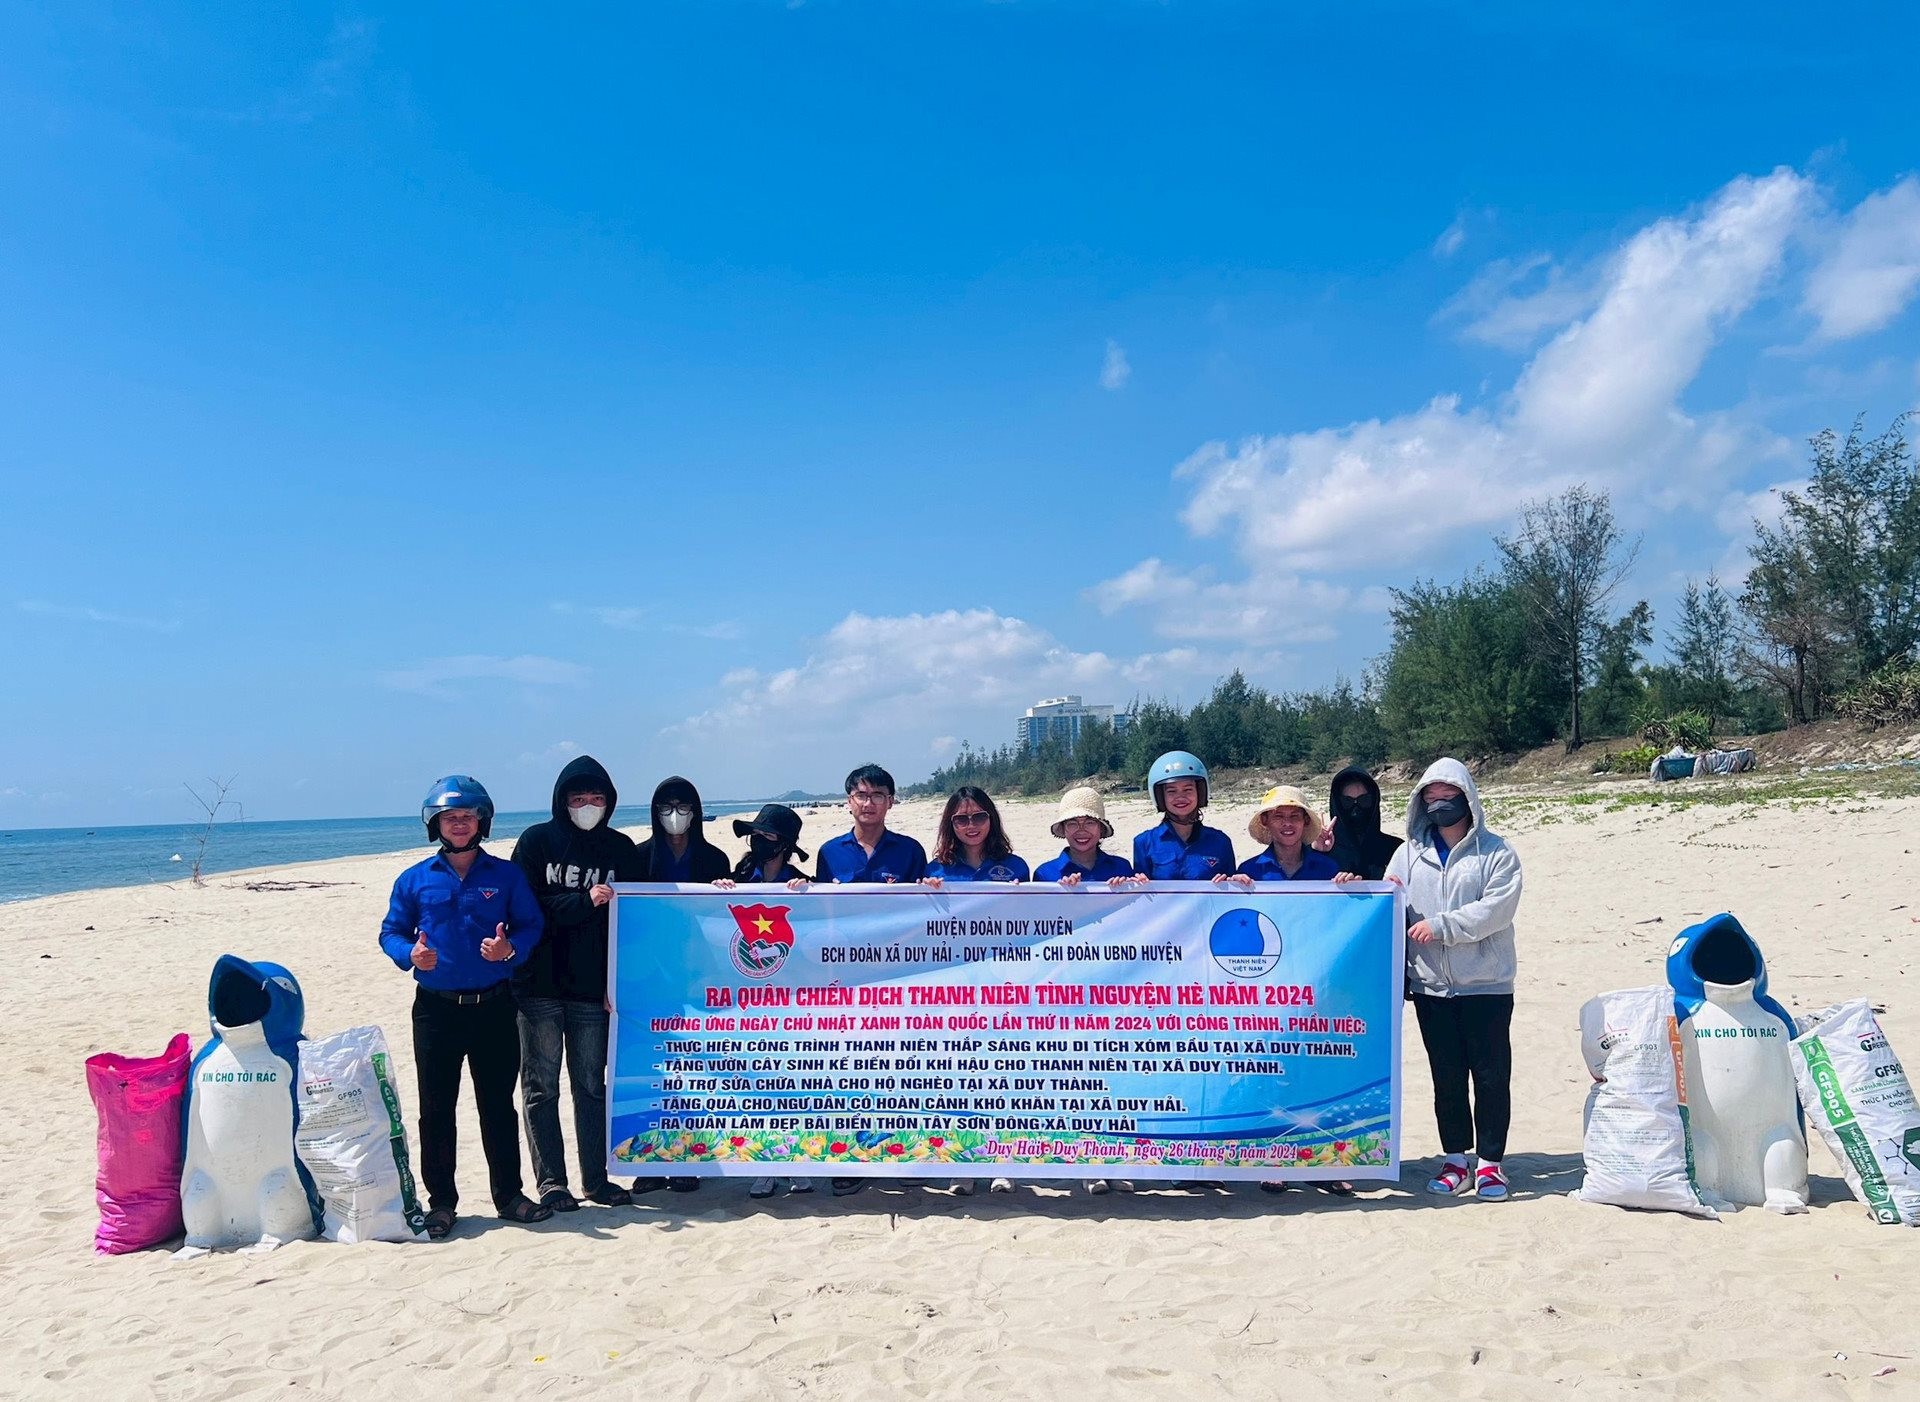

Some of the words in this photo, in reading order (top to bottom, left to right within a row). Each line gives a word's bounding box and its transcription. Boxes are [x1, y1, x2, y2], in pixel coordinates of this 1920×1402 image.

[927, 916, 966, 939] HUYỆN
[970, 916, 1001, 936] ĐOÀN
[1006, 920, 1030, 936] DUY
[1033, 916, 1073, 936] XUYÊN
[822, 947, 846, 963] BCH
[850, 943, 881, 962] ĐOÀN
[885, 943, 900, 962] XÃ
[904, 947, 928, 962] DUY
[932, 940, 951, 962] HẢI
[964, 946, 988, 962] DUY
[991, 942, 1031, 962] THÀNH
[1043, 946, 1063, 961] CHI
[1067, 941, 1100, 961] ĐOÀN
[1104, 945, 1137, 961] UBND
[1141, 941, 1182, 965] HUYỆN
[706, 987, 732, 1007] RA
[737, 984, 790, 1011] QUÂN
[796, 980, 854, 1006] CHIẾN
[859, 986, 903, 1009] DỊCH
[908, 986, 975, 1005] THANH
[981, 982, 1030, 1005] NIÊN
[1035, 982, 1083, 1005] TÌNH
[1089, 982, 1171, 1009] NGUYỆN
[1177, 982, 1204, 1005] HÈ
[1209, 981, 1259, 1005] NĂM
[1264, 985, 1314, 1005] 2024
[651, 1014, 700, 1031] HƯỞNG
[705, 1015, 736, 1031] ỨNG
[740, 1015, 778, 1030] NGÀY
[783, 1013, 813, 1030] CHỦ
[817, 1014, 856, 1033] NHẬT
[860, 1016, 900, 1030] XANH
[905, 1014, 943, 1030] TOÀN
[948, 1012, 988, 1031] QUỐC
[993, 1012, 1022, 1030] LẦN
[1026, 1014, 1056, 1030] THỨ
[1060, 1016, 1069, 1030] II
[1074, 1014, 1110, 1030] NĂM
[1114, 1016, 1152, 1030] 2024
[1157, 1014, 1181, 1030] VỚI
[1186, 1014, 1229, 1031] CÔNG
[1233, 1014, 1284, 1032] TRÌNH,
[1288, 1013, 1329, 1032] PHẦN
[1333, 1016, 1366, 1036] VIỆC:
[1694, 1028, 1711, 1038] XIN
[1715, 1028, 1737, 1038] CHO
[1741, 1025, 1757, 1038] TÔI
[1760, 1025, 1777, 1037] RÁC
[665, 1041, 701, 1054] THỰC
[706, 1039, 742, 1055] HIỆN
[747, 1039, 789, 1052] CÔNG
[794, 1040, 839, 1052] TRÌNH
[844, 1040, 895, 1051] THANH
[900, 1038, 938, 1051] NIÊN
[942, 1035, 982, 1051] THẮP
[987, 1038, 1031, 1052] SÁNG
[1036, 1040, 1067, 1052] KHU
[1073, 1040, 1088, 1052] DI
[1094, 1038, 1129, 1052] TÍCH
[1134, 1038, 1171, 1052] XÓM
[1214, 1041, 1239, 1056] TẠI
[1244, 1040, 1266, 1054] XÃ
[1271, 1042, 1301, 1054] DUY
[1305, 1041, 1356, 1057] THÀNH,
[215, 1073, 234, 1082] CHO
[237, 1069, 253, 1082] TÔI
[256, 1070, 277, 1082] RÁC
[664, 1057, 703, 1073] TẶNG
[708, 1057, 747, 1071] VƯỜN
[752, 1057, 782, 1071] CÂY
[786, 1059, 824, 1070] SINH
[829, 1055, 850, 1070] KẾ
[854, 1055, 890, 1070] BIẾN
[894, 1055, 920, 1070] ĐỔI
[926, 1057, 952, 1070] KHÍ
[957, 1057, 988, 1073] HẬU
[994, 1059, 1026, 1071] CHO
[1030, 1059, 1083, 1071] THANH
[1089, 1057, 1127, 1071] NIÊN
[1132, 1060, 1157, 1074] TẠI
[1162, 1058, 1185, 1072] XÃ
[1190, 1060, 1221, 1072] DUY
[1226, 1058, 1283, 1074] THÀNH.
[663, 1075, 683, 1091] HỖ
[688, 1078, 717, 1093] TRỢ
[721, 1076, 751, 1091] SỬA
[755, 1077, 796, 1090] CHỮA
[801, 1077, 833, 1090] NHÀ
[838, 1078, 869, 1090] CHO
[874, 1076, 896, 1092] HỘ
[900, 1076, 953, 1090] NGHÈO
[958, 1078, 983, 1093] TẠI
[988, 1076, 1009, 1090] XÃ
[1014, 1078, 1046, 1091] DUY
[1050, 1077, 1108, 1091] THÀNH.
[1817, 1071, 1846, 1118] GF905
[661, 1096, 701, 1113] TẶNG
[706, 1096, 737, 1111] QUÀ
[741, 1098, 772, 1110] CHO
[777, 1098, 810, 1110] NGƯ
[813, 1095, 846, 1109] DÂN
[850, 1095, 872, 1110] CÓ
[876, 1095, 920, 1109] HOÀN
[925, 1094, 968, 1110] CẢNH
[973, 1095, 1006, 1110] KHÓ
[1011, 1096, 1055, 1110] KHĂN
[1060, 1098, 1085, 1113] TẠI
[1090, 1096, 1112, 1110] XÃ
[1117, 1099, 1149, 1111] DUY
[1153, 1096, 1186, 1112] HẢI.
[661, 1118, 680, 1130] RA
[684, 1115, 726, 1130] QUÂN
[731, 1115, 764, 1129] LÀM
[769, 1118, 800, 1132] ĐẸP
[804, 1115, 830, 1129] BÃI
[835, 1113, 872, 1129] BIỂN
[876, 1115, 919, 1129] THÔN
[923, 1115, 951, 1129] TÂY
[957, 1117, 990, 1129] SƠN
[994, 1115, 1040, 1130] ĐÔNG
[1044, 1116, 1066, 1130] XÃ
[1072, 1119, 1104, 1131] DUY
[1108, 1115, 1135, 1131] HẢI
[987, 1140, 1013, 1158] Duy
[1016, 1137, 1042, 1155] Hải
[1053, 1141, 1079, 1159] Duy
[1083, 1140, 1129, 1158] Thành,
[1133, 1144, 1166, 1160] ngày
[1168, 1142, 1184, 1157] 26
[1187, 1142, 1224, 1161] tháng
[1228, 1144, 1236, 1158] 5
[1240, 1145, 1267, 1158] năm
[1270, 1144, 1297, 1159] 2024
